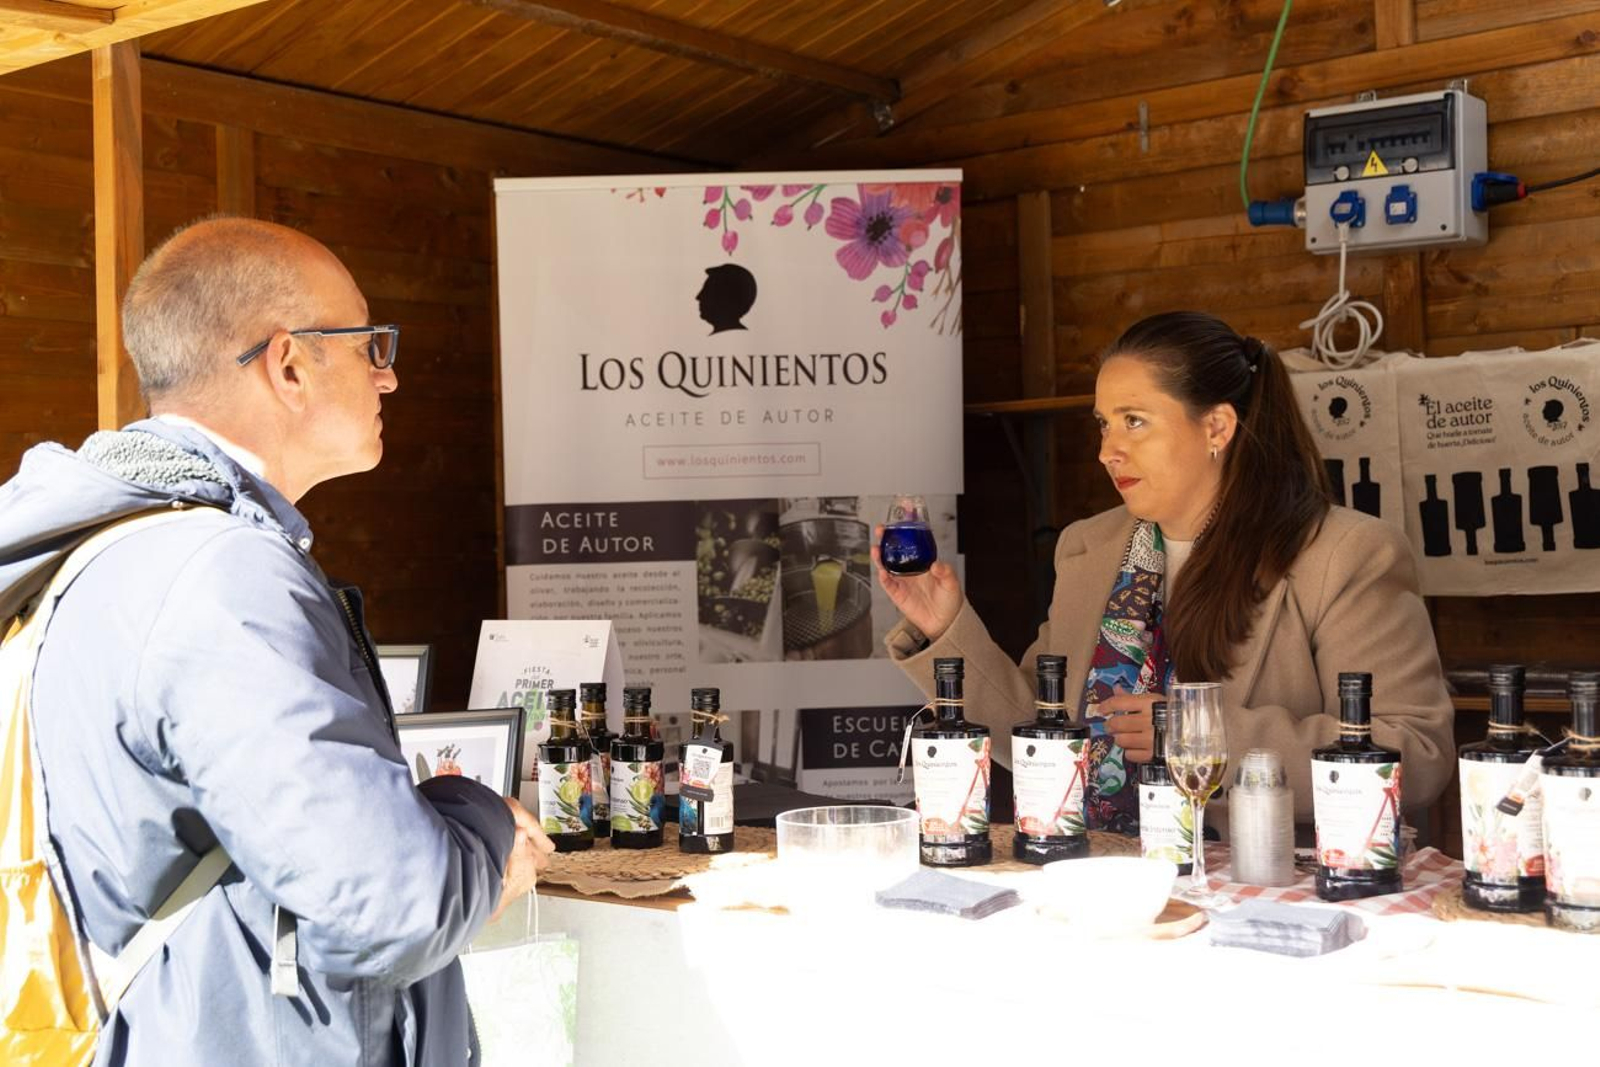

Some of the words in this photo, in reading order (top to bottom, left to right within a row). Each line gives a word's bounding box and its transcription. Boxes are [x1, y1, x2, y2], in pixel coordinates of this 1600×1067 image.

[579, 353, 645, 391] LOS
[656, 350, 888, 398] QUINIENTOS
[1335, 376, 1371, 419] Quinientos
[1529, 380, 1547, 394] los
[1548, 376, 1590, 422] Quinientos
[1426, 400, 1441, 415] El
[1445, 396, 1493, 414] aceite
[625, 411, 705, 427] ACEITE
[720, 409, 746, 425] DE
[762, 408, 835, 424] AUTOR
[1426, 414, 1446, 429] de
[1450, 413, 1493, 427] autor
[1550, 432, 1575, 446] autor
[656, 452, 807, 468] www.losquinientos.com
[540, 511, 619, 530] ACEITE
[542, 537, 571, 554] DE
[579, 535, 655, 553] AUTOR
[530, 572, 571, 581] Cuidamos
[575, 572, 608, 580] nuestro
[643, 570, 668, 579] desde
[672, 570, 681, 578] el
[563, 585, 609, 596] trabajando
[617, 584, 625, 593] la
[630, 583, 681, 593] recolección,
[530, 600, 583, 609] elaboración,
[587, 598, 615, 608] diseño
[639, 611, 682, 621] Aplicamos
[647, 625, 683, 633] nuestros
[649, 666, 687, 675] personal
[515, 679, 555, 690] PRIMER
[496, 691, 549, 710] ACEI
[833, 743, 861, 758] DE
[823, 779, 868, 788] Apostamos
[873, 779, 887, 787] por
